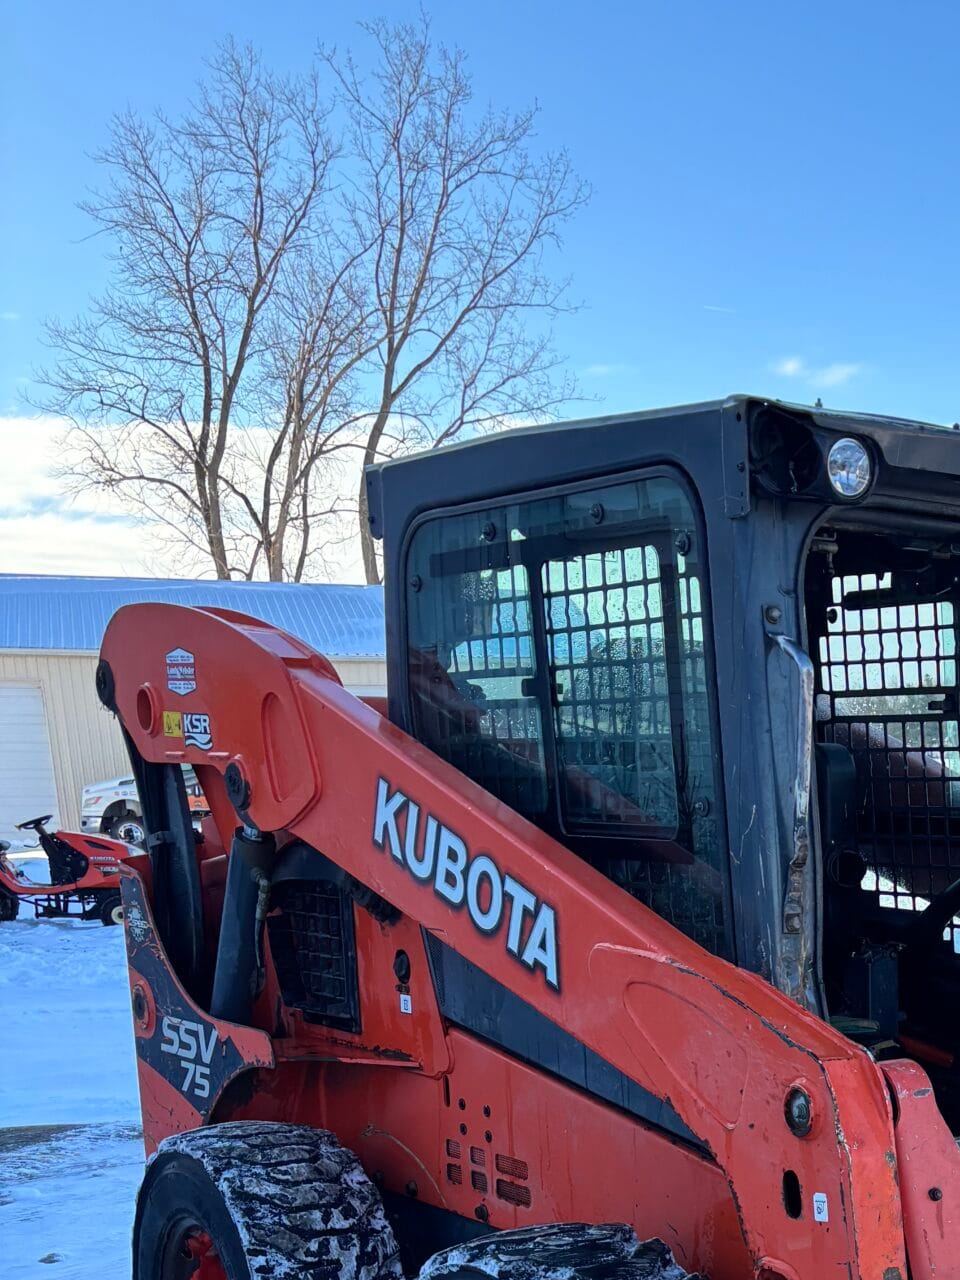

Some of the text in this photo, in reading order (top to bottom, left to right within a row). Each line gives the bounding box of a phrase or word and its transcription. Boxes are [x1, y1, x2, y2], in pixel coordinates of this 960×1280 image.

[183, 714, 211, 733] KSR
[373, 777, 560, 990] KUBOTA
[161, 1016, 219, 1065] SSV
[181, 1061, 211, 1098] 75
